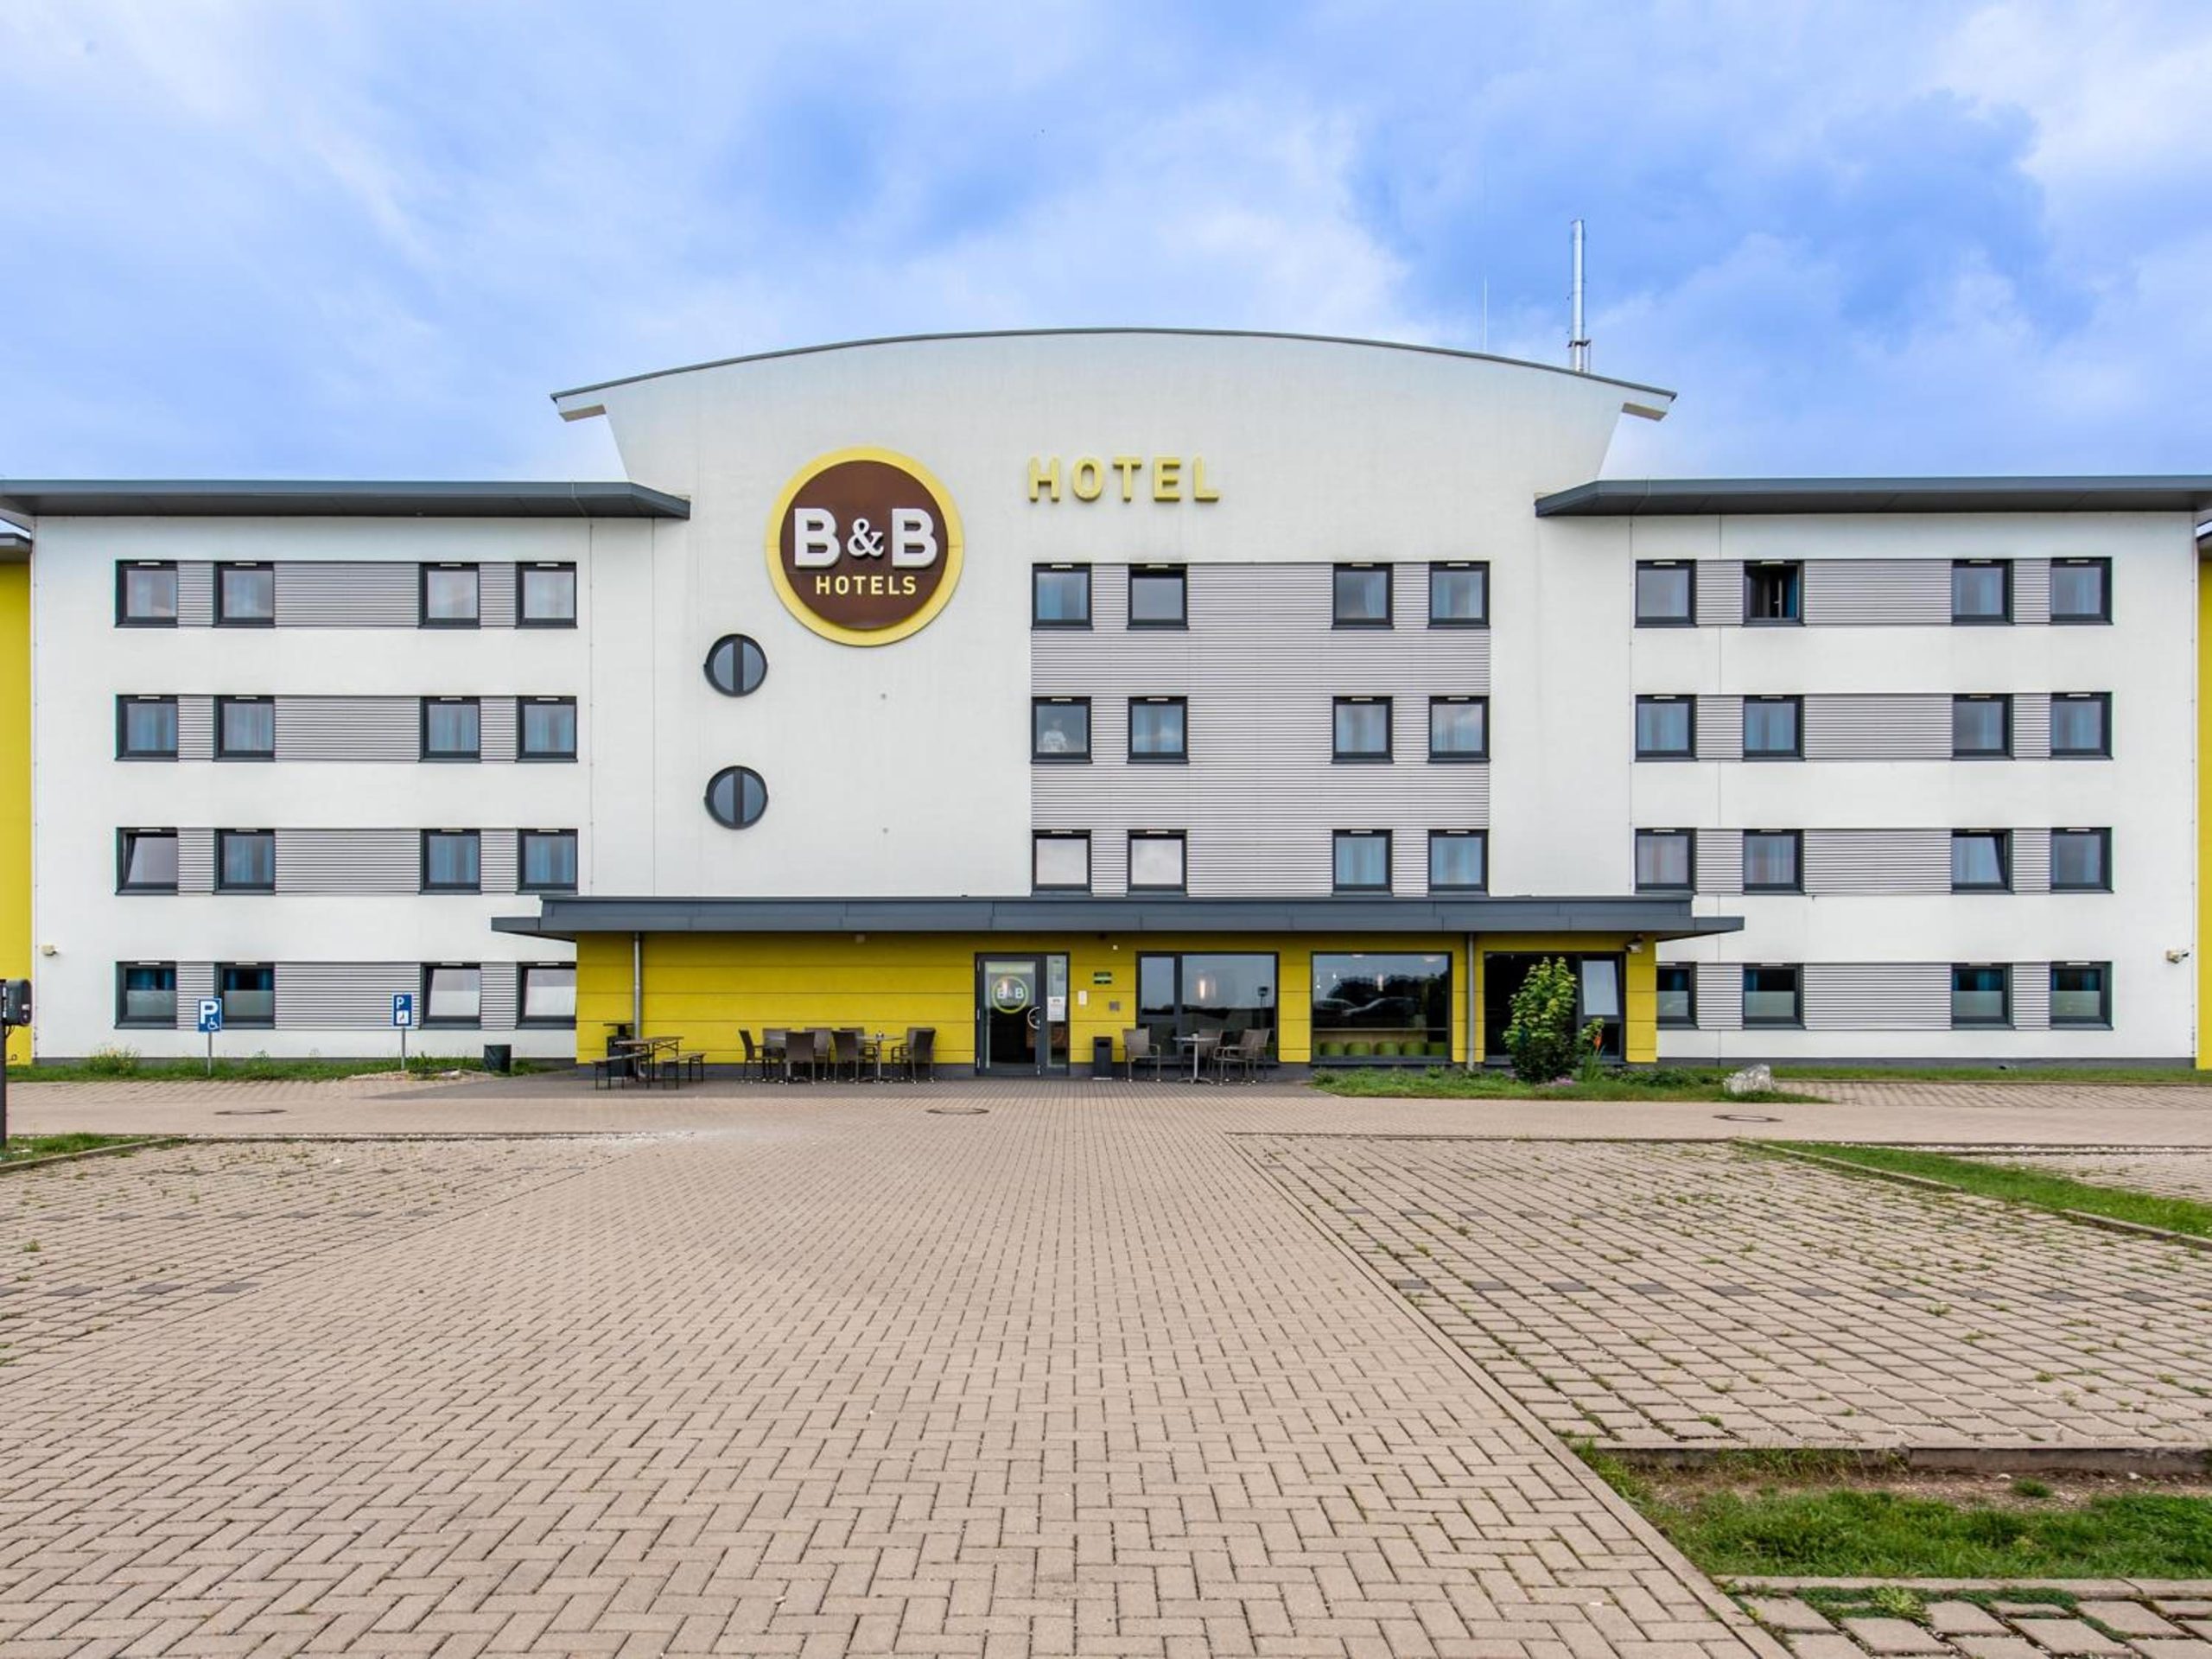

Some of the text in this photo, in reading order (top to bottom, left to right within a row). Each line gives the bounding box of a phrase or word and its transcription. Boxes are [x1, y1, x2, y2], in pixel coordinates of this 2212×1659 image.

[1028, 455, 1219, 503] HOTEL
[794, 508, 938, 568] B&B
[816, 575, 917, 594] HOTELS
[200, 1001, 219, 1024] P
[396, 996, 404, 1009] P
